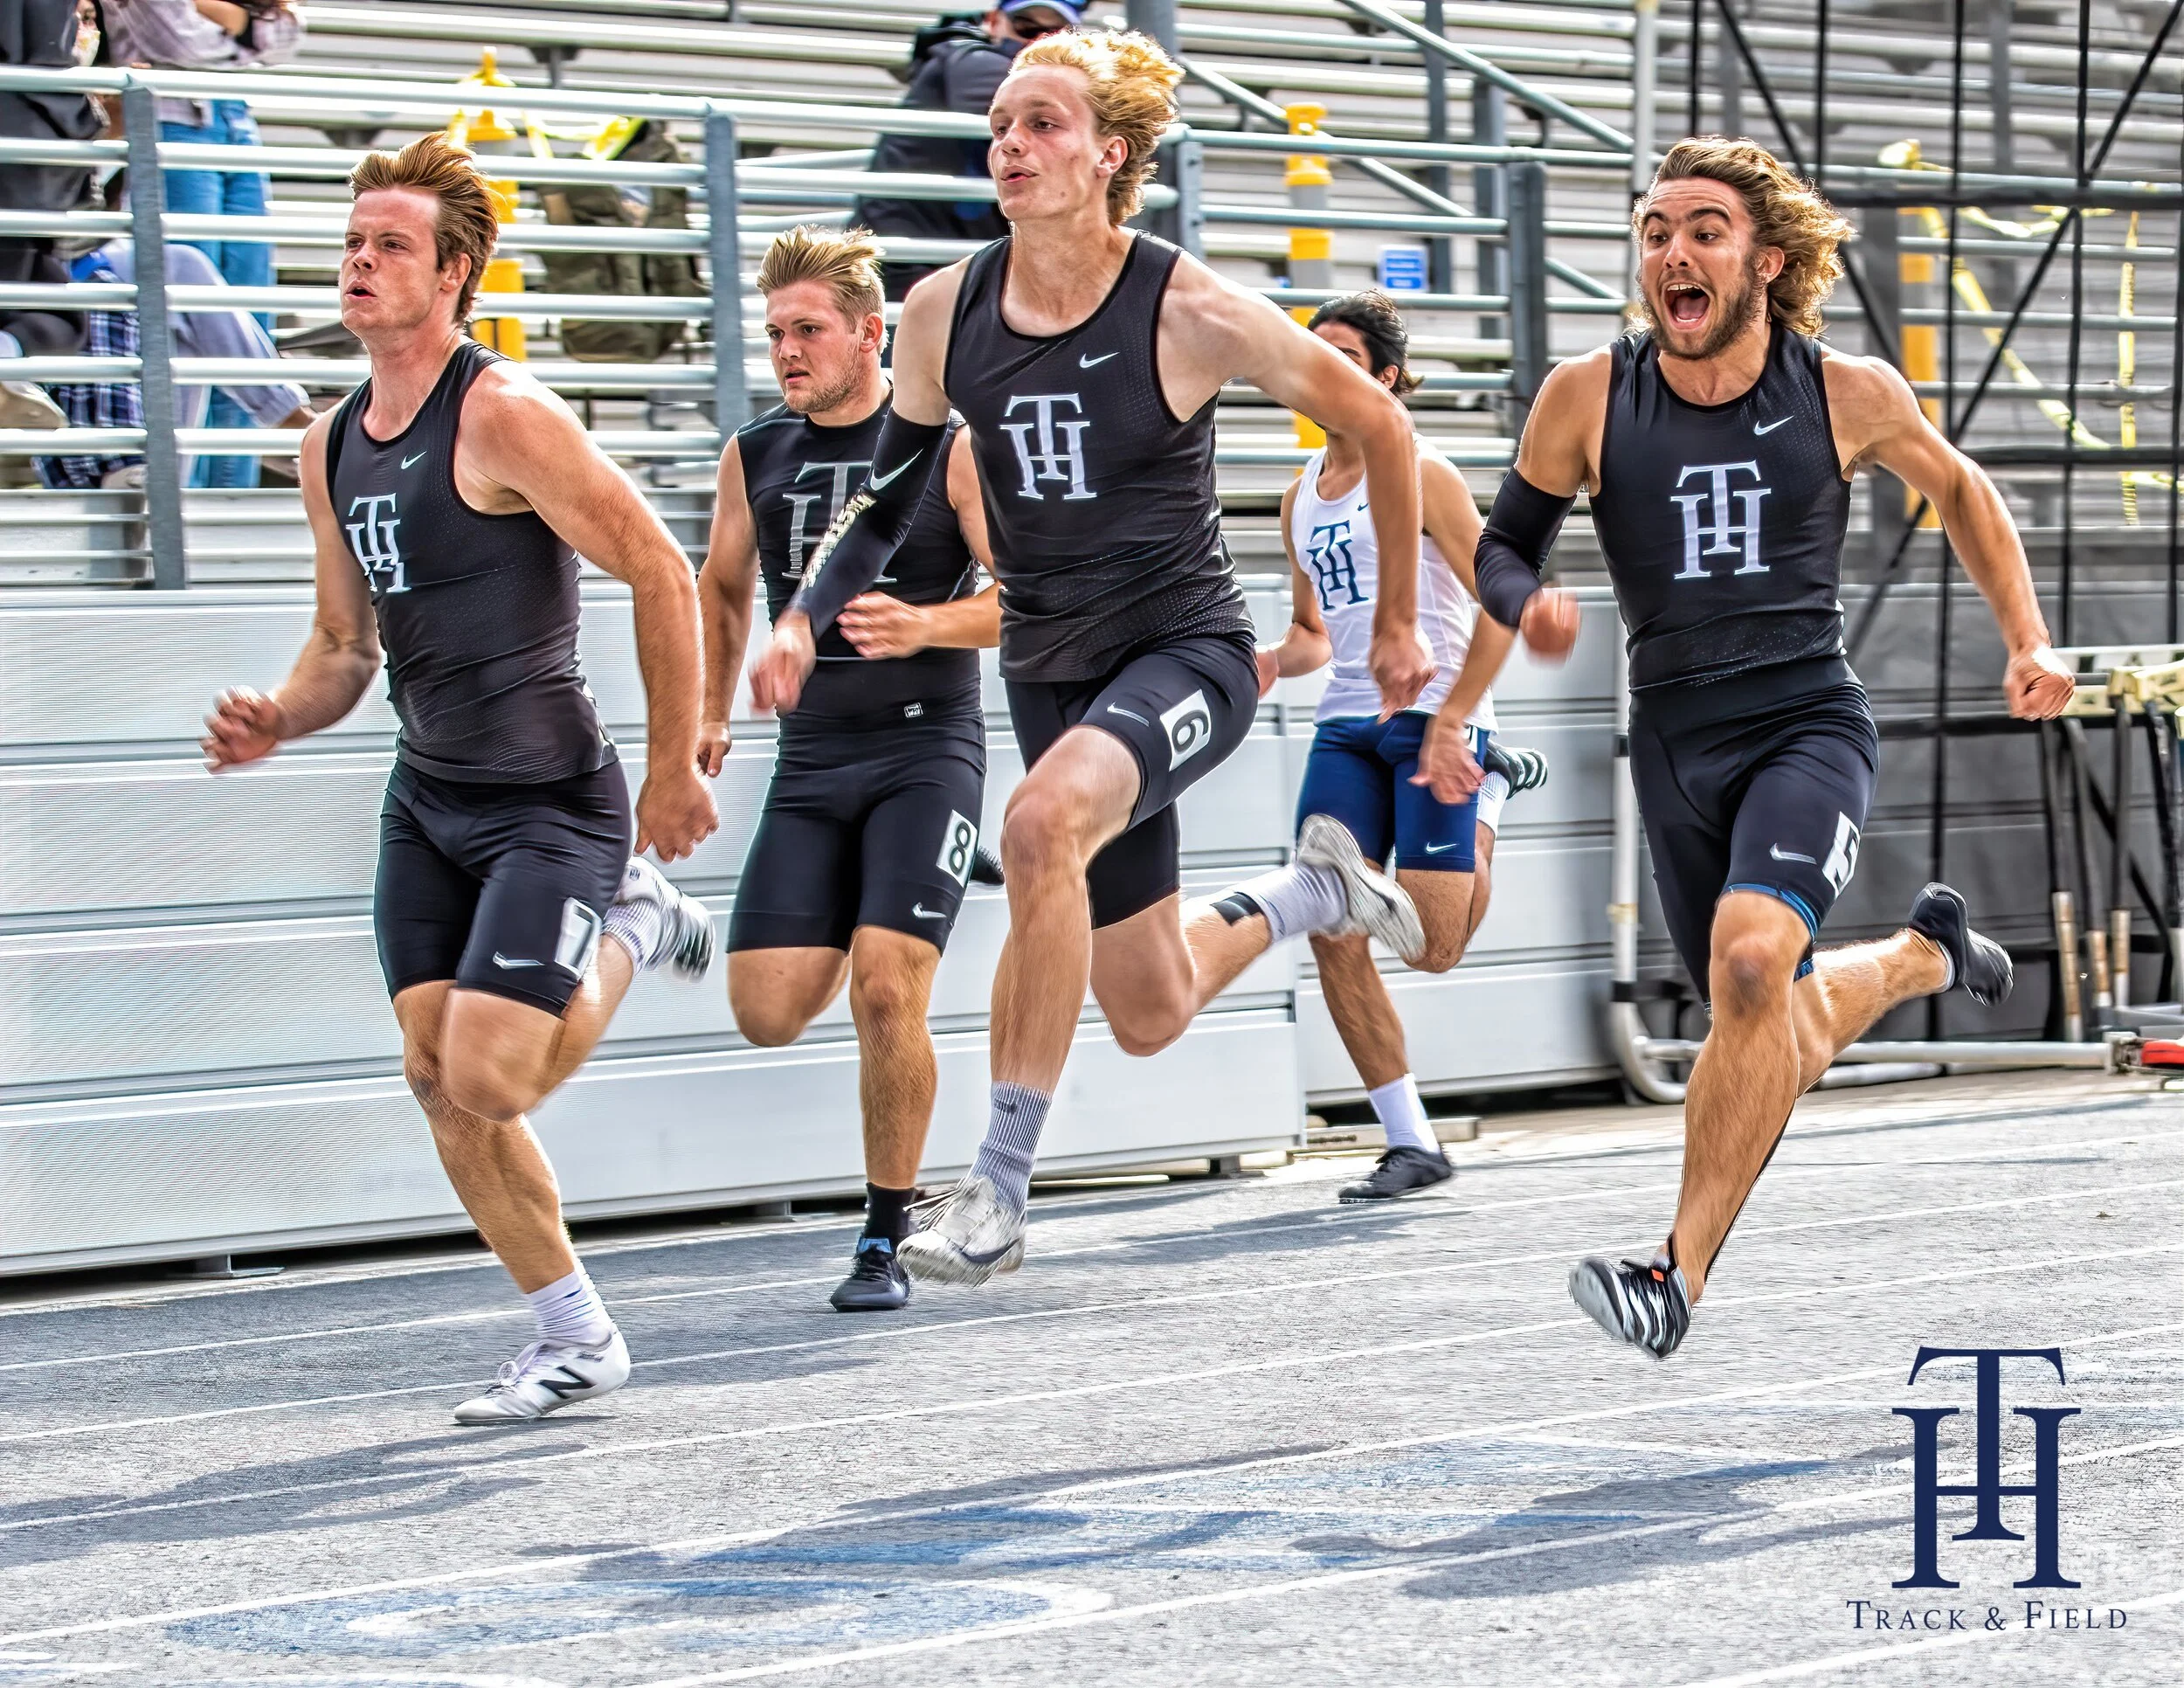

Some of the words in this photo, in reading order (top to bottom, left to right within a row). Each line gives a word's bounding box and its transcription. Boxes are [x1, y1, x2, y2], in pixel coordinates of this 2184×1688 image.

[999, 392, 1098, 501] TH
[1669, 459, 1772, 580] TH
[1171, 709, 1209, 755] 6
[949, 820, 971, 876] 8
[568, 903, 595, 971] 7
